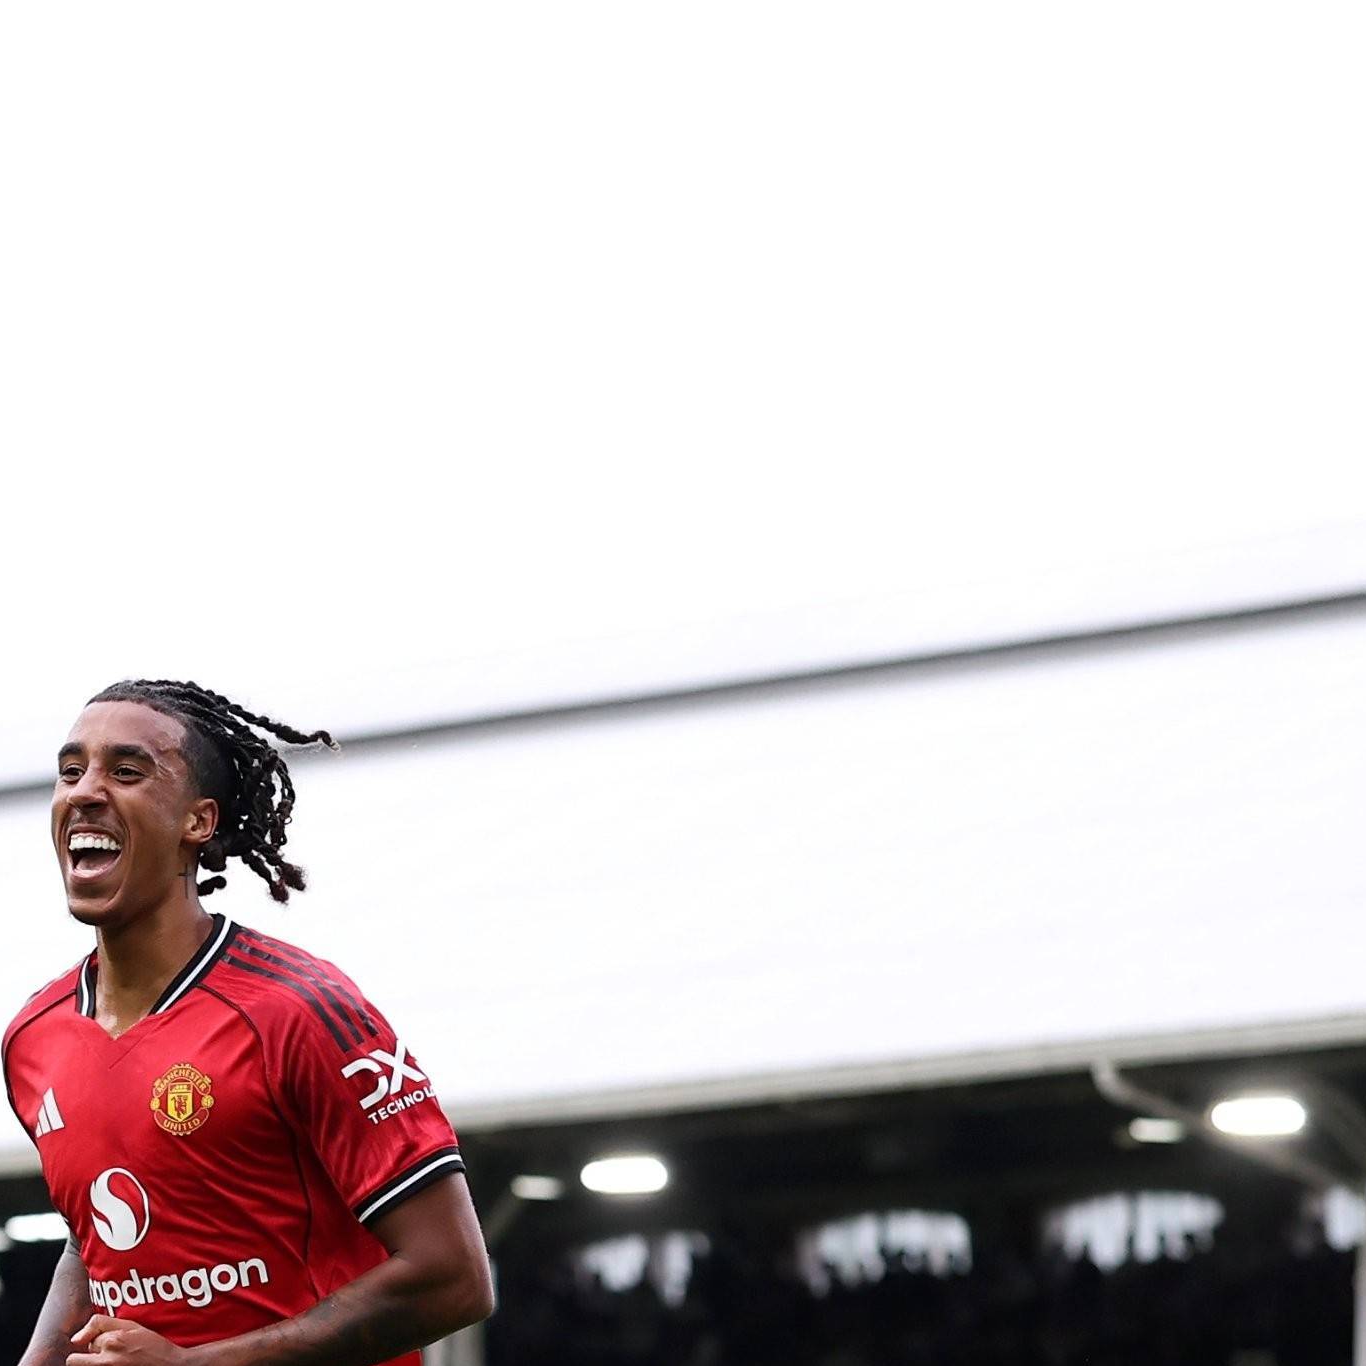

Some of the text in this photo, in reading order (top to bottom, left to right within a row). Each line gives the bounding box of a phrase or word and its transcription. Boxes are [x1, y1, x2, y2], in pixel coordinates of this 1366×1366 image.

[155, 1068, 208, 1093] MANCHESTER
[163, 1117, 201, 1132] UNITED
[89, 1257, 269, 1318] napdragon
